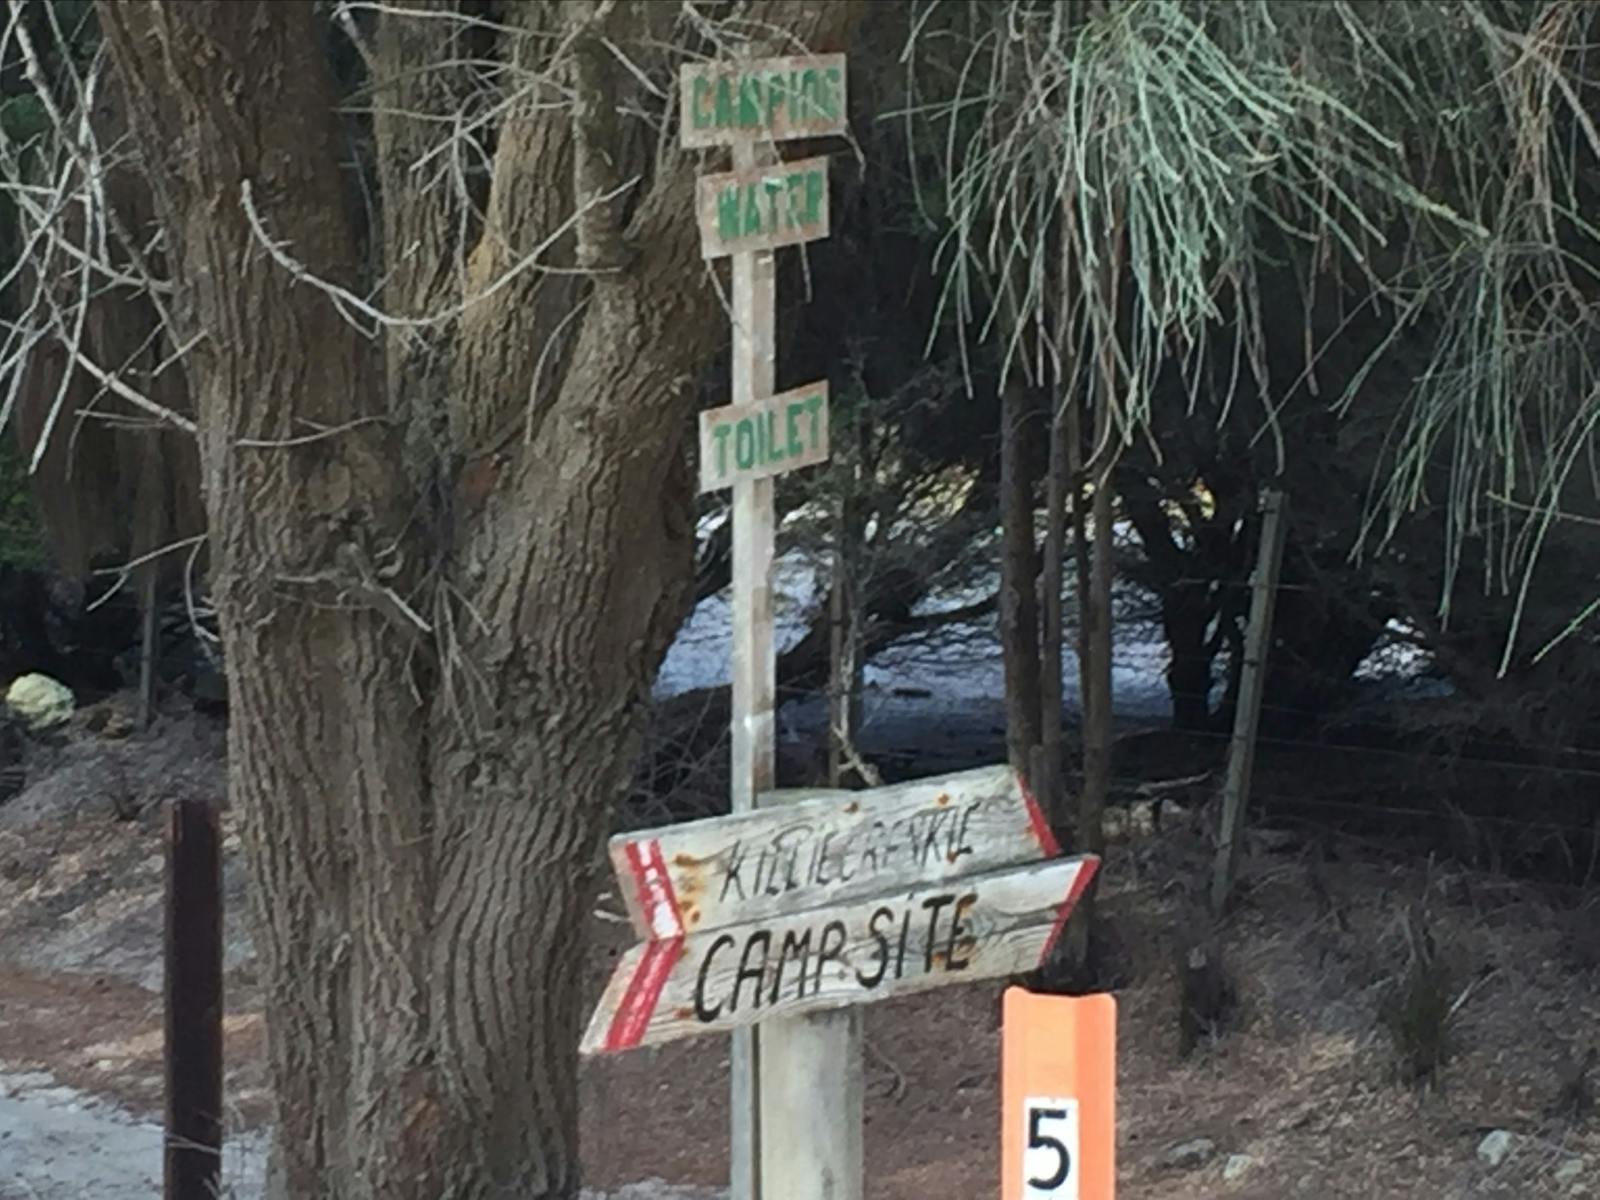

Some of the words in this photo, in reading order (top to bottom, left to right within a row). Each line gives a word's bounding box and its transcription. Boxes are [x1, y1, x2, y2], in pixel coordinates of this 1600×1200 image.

[712, 395, 824, 478] TOILET
[695, 919, 848, 1023] CAMP
[855, 893, 979, 989] SITE
[1027, 1107, 1071, 1191] 5
